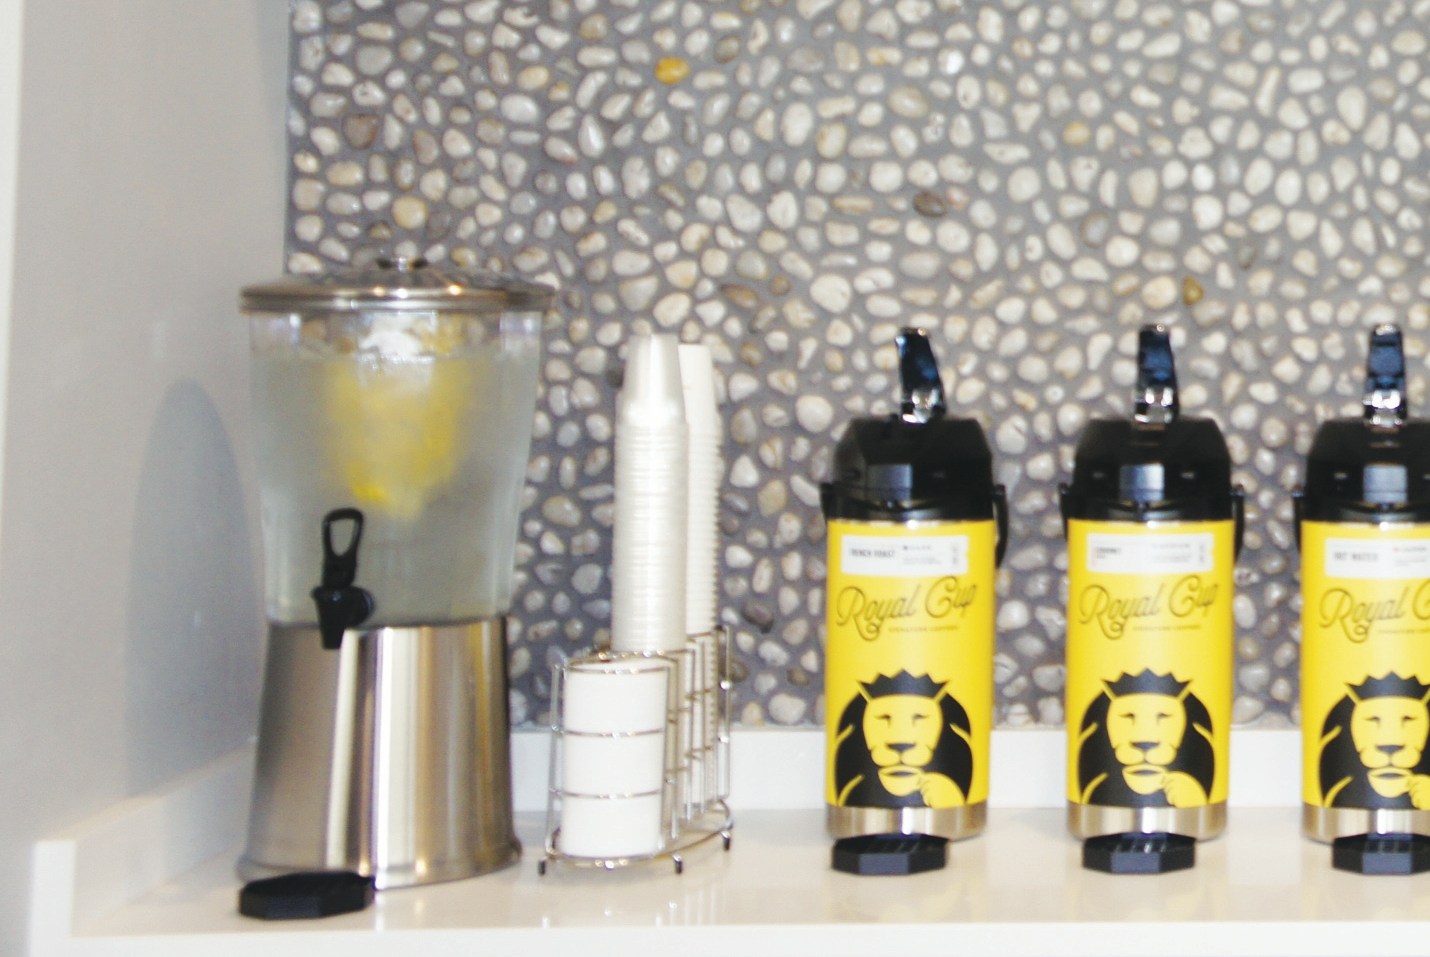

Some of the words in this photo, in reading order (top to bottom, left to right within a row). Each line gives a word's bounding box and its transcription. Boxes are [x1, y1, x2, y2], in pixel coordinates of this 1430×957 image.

[836, 583, 922, 642] Royal
[925, 575, 977, 619] Cup
[1078, 582, 1165, 641] Royal
[1168, 574, 1219, 618] Cup
[1318, 586, 1410, 644] Royal
